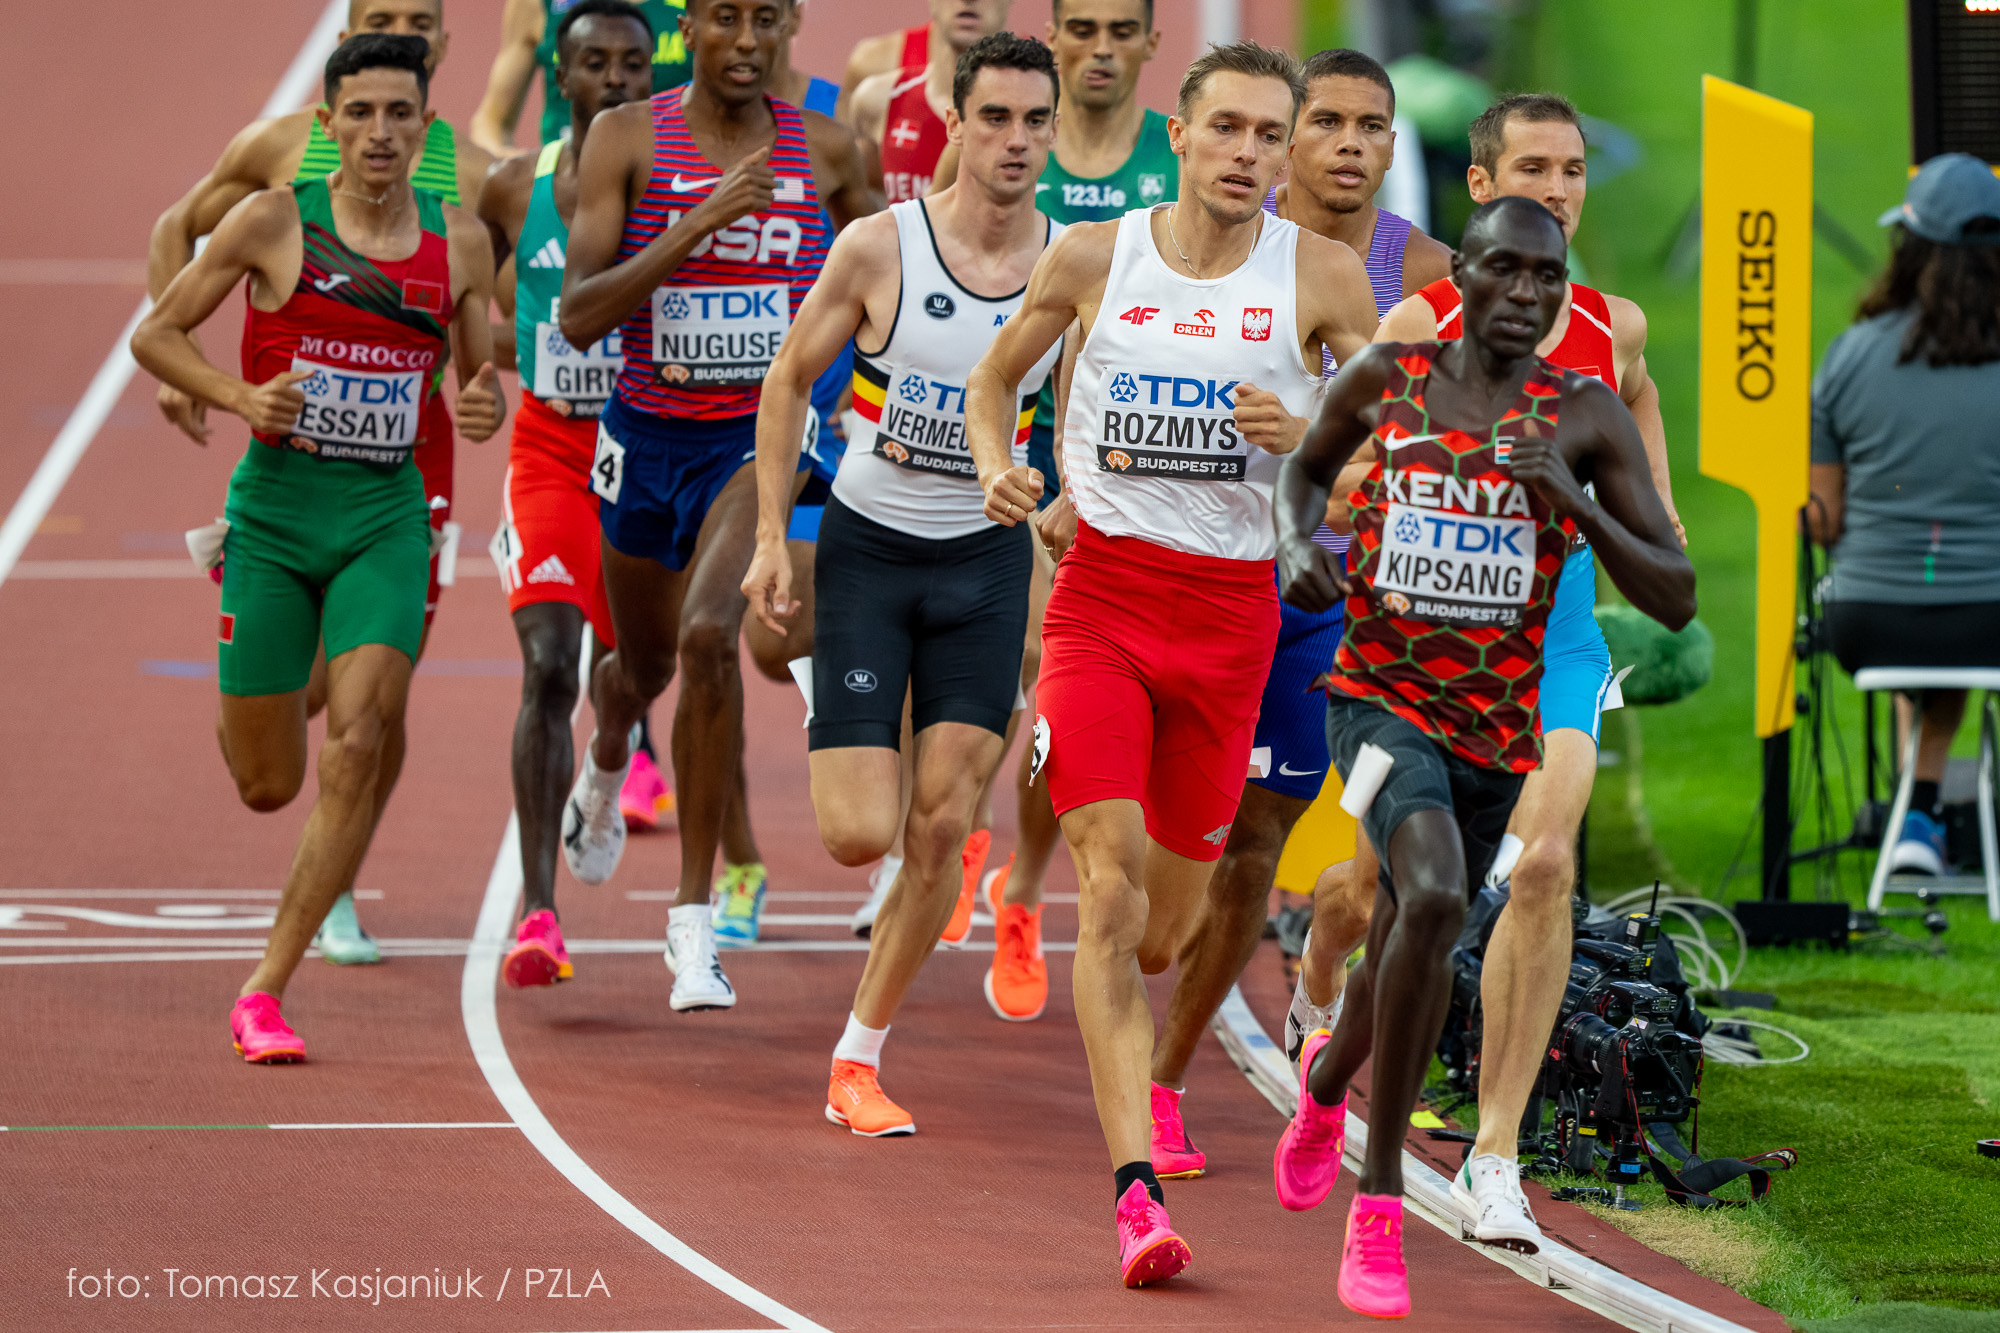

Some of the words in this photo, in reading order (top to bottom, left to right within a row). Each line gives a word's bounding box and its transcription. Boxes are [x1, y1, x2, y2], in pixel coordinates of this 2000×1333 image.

[1061, 184, 1126, 207] 123.ie
[690, 290, 779, 320] TDK
[1737, 211, 1776, 402] SEIKO
[1175, 324, 1213, 337] ORLEN
[299, 335, 434, 369] MOROCCO
[331, 374, 414, 405] TDK
[1139, 374, 1240, 410] TDK
[298, 403, 406, 442] ESSAYI
[1104, 410, 1238, 451] ROZMYS
[321, 444, 396, 463] BUDAPEST
[1137, 456, 1219, 474] BUDAPEST
[1220, 462, 1238, 474] 23
[597, 453, 615, 490] 4
[1383, 469, 1531, 518] KENYA
[1424, 516, 1523, 557] TDK
[1387, 551, 1522, 598] KIPSANG
[1414, 601, 1501, 621] BUDAPEST
[1501, 608, 1518, 622] 23
